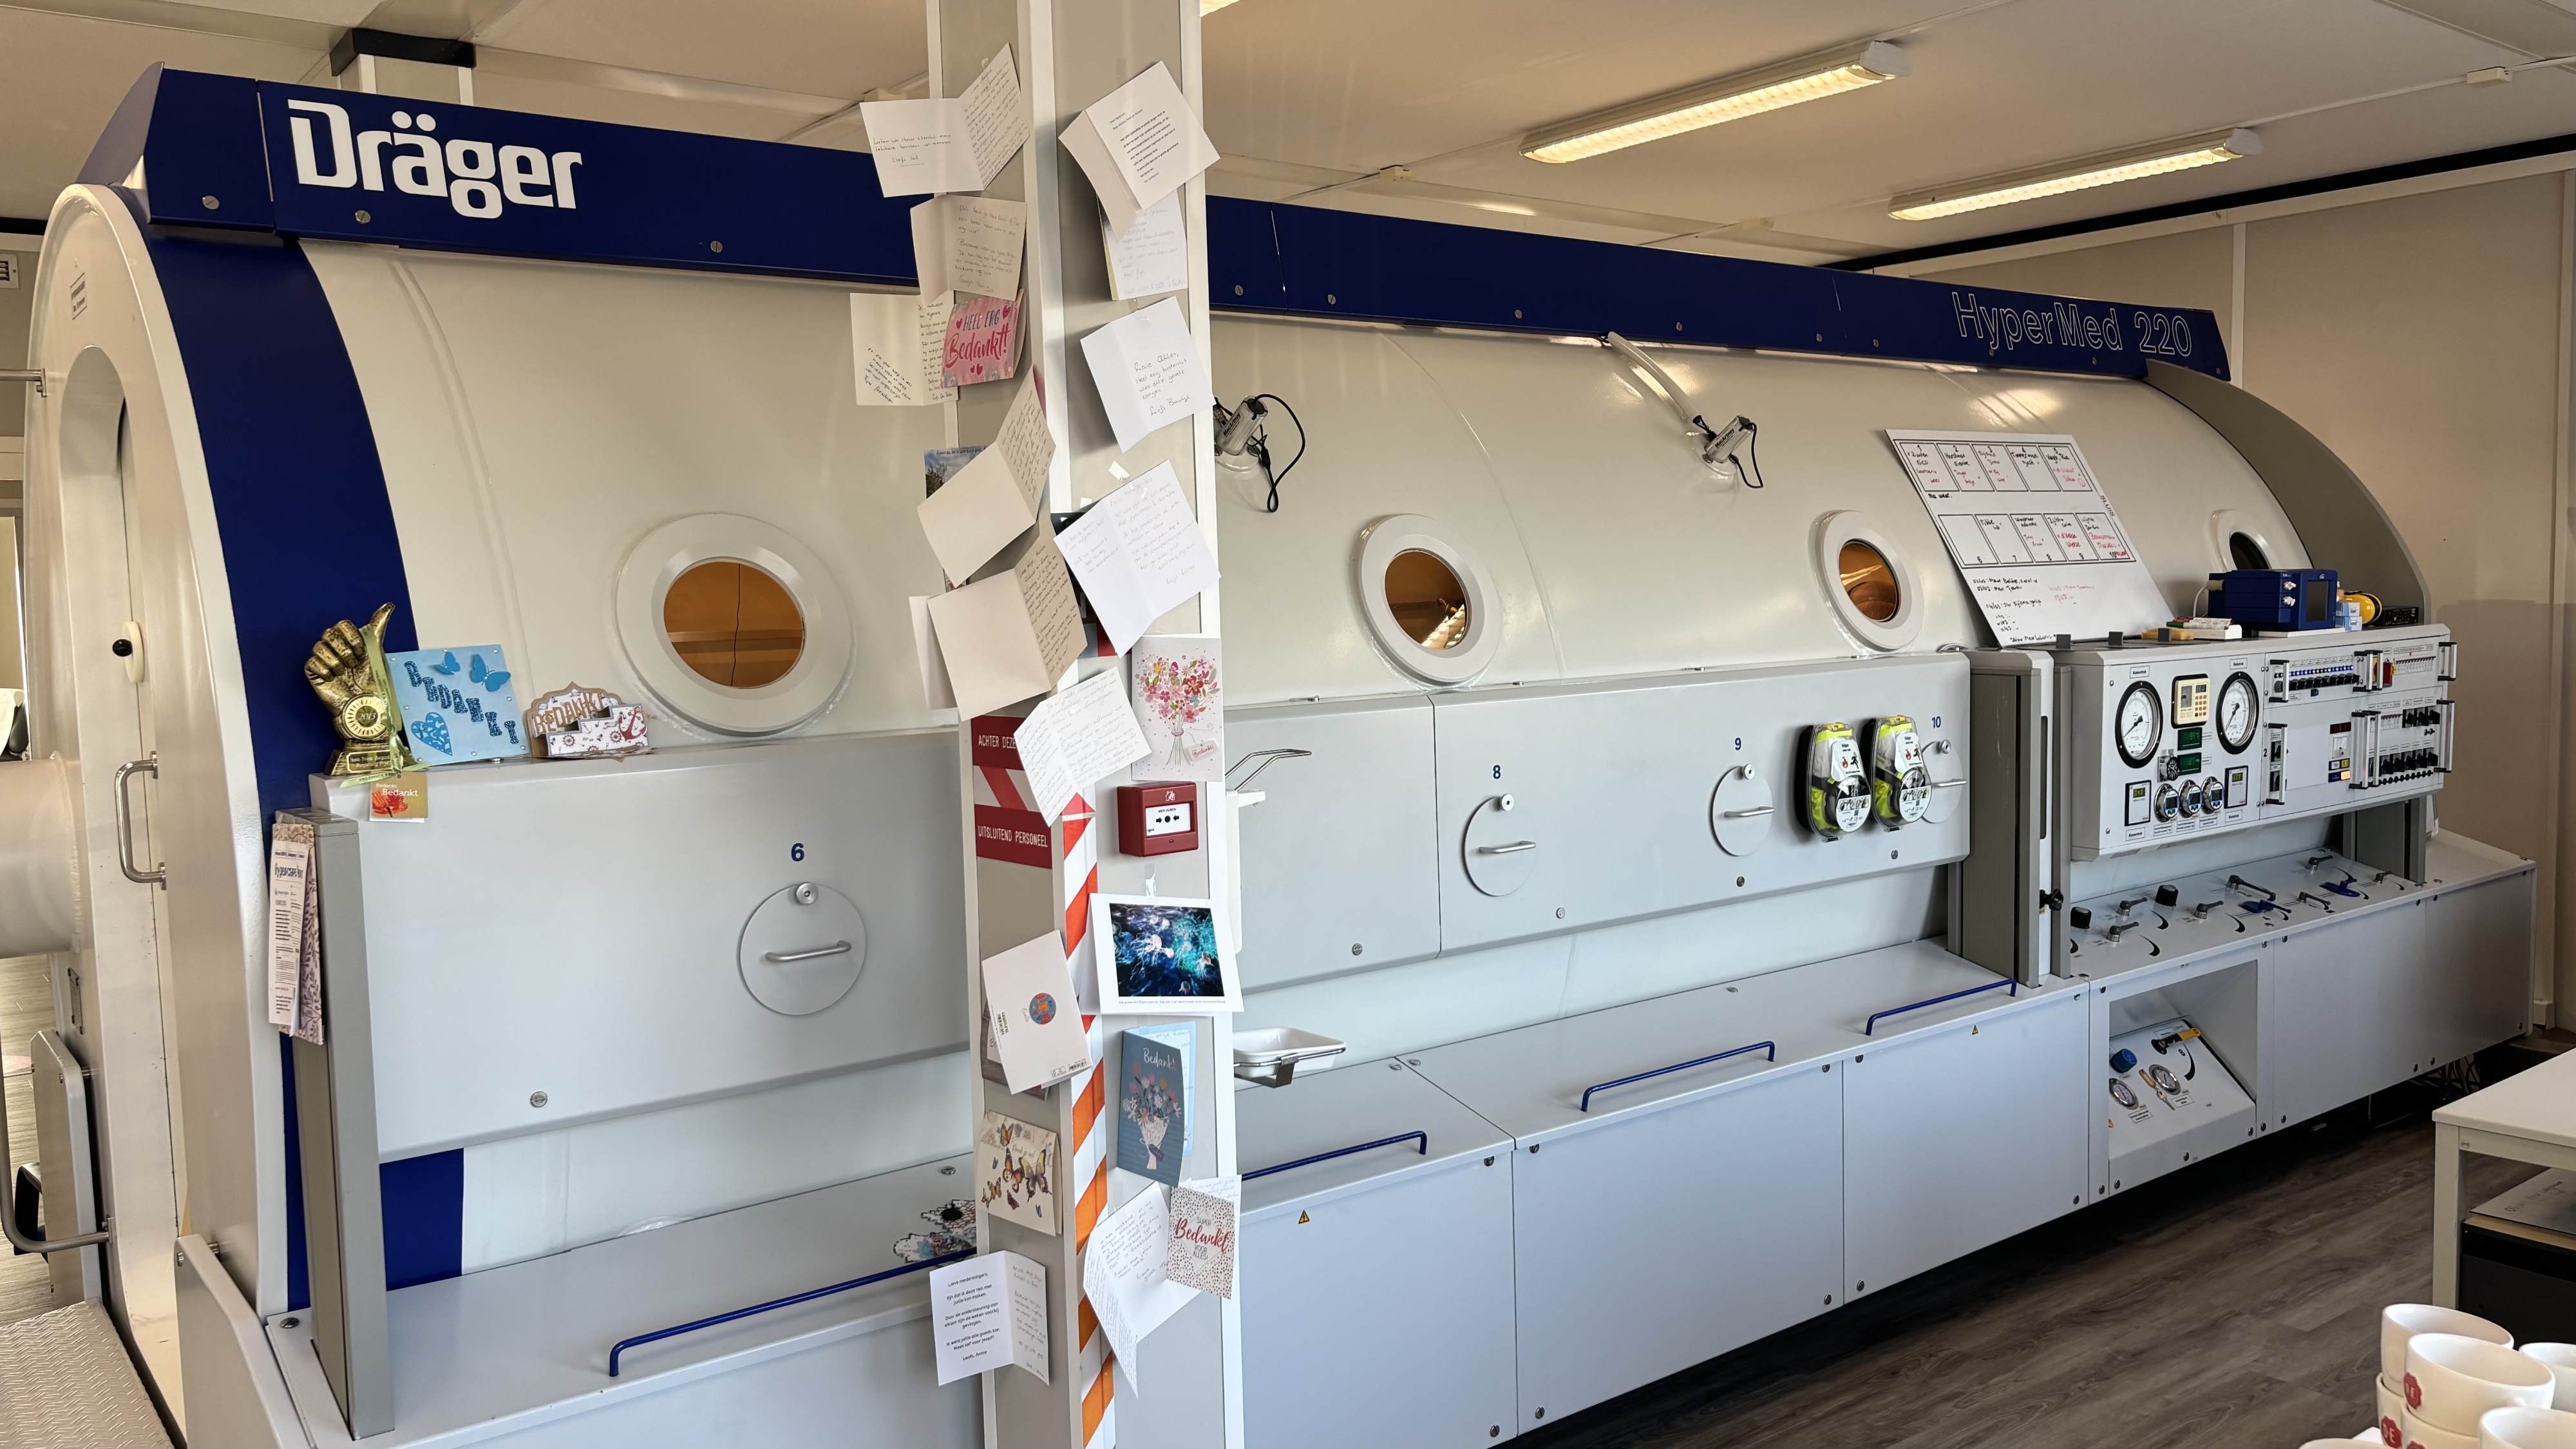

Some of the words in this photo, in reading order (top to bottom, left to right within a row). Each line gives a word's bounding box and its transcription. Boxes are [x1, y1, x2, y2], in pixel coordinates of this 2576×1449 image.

[288, 99, 583, 219] Dräger
[963, 314, 980, 331] HEEL
[985, 309, 1000, 327] ERG
[1951, 291, 2123, 351] HyperMed
[2135, 311, 2192, 357] 220
[945, 323, 1011, 369] Bedankt!
[404, 660, 520, 744] BEDANKT
[533, 692, 605, 735] BEDANKT
[1932, 715, 1941, 729] 10
[978, 734, 999, 747] ACHTER
[1002, 736, 1016, 749] DEZE
[1735, 737, 1741, 750] 9
[1493, 764, 1501, 780] 8
[978, 825, 1012, 842] UITSLUITEND
[1015, 830, 1048, 848] PERSONEEL
[791, 842, 805, 862] 6
[1143, 1048, 1177, 1070] Bedankt
[1197, 1217, 1211, 1226] SUPER
[1175, 1217, 1229, 1254] Bedankt
[1193, 1251, 1208, 1260] ALLES!
[1195, 1244, 1208, 1253] VOOR
